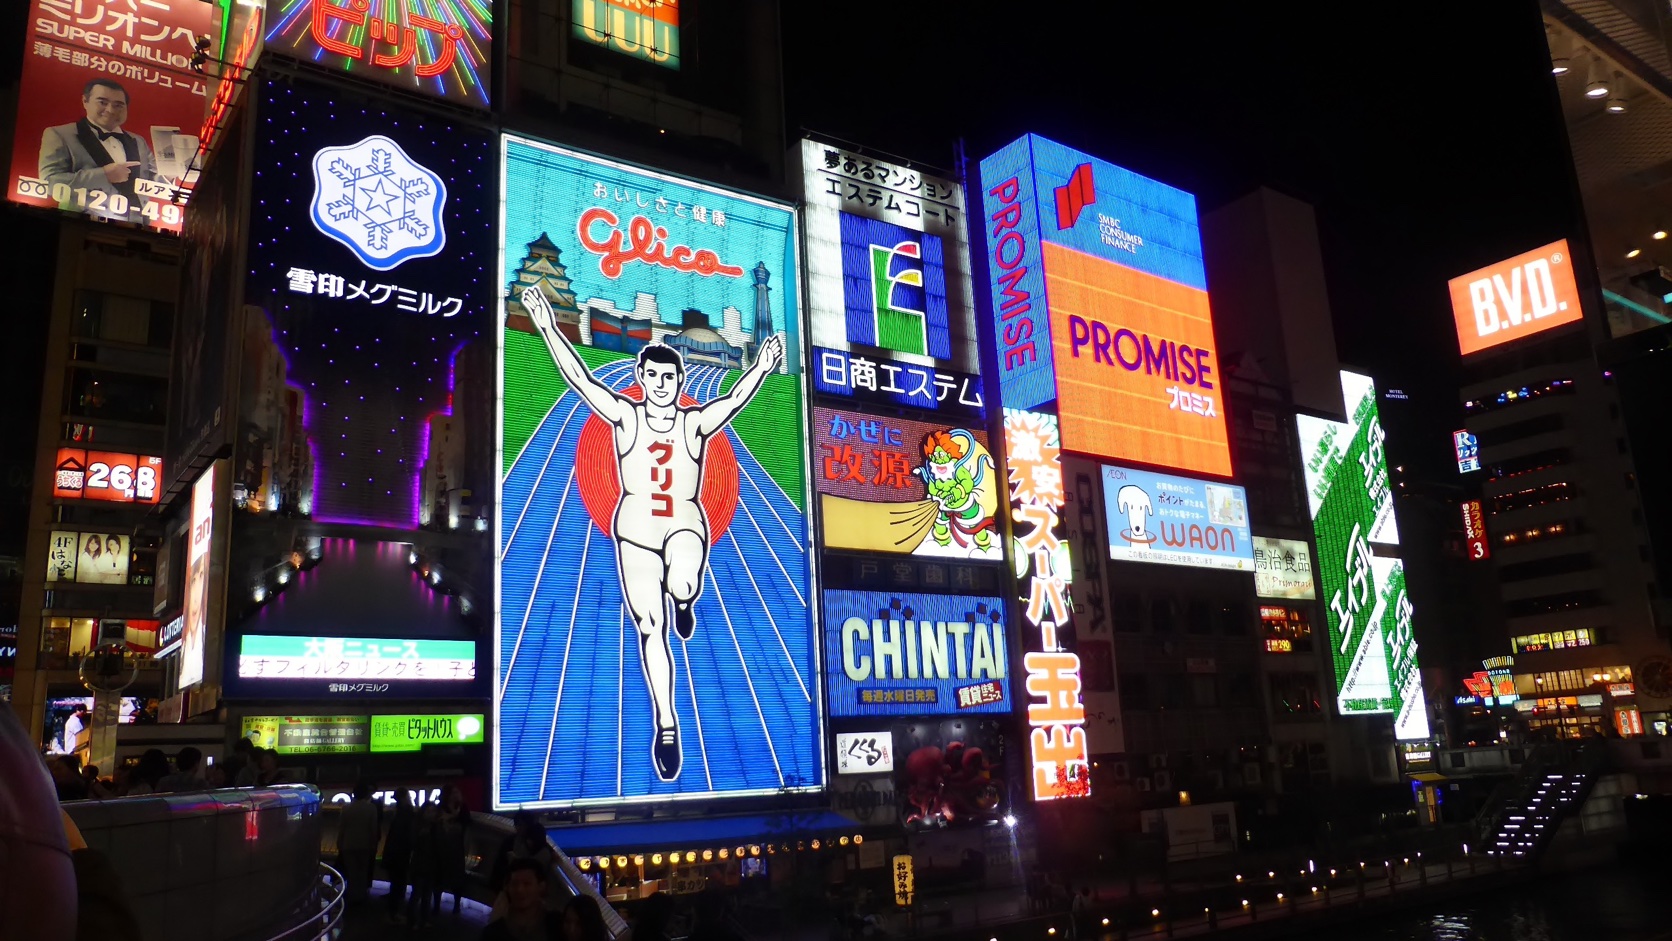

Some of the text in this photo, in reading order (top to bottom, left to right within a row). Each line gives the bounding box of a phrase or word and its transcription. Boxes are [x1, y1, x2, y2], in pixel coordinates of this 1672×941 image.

[35, 18, 115, 50] SUPER
[38, 0, 211, 47] ミリオンヘ
[33, 41, 207, 96] 薄毛部分のボリューム
[824, 149, 953, 200] 夢あるマンション
[52, 183, 183, 225] 0120-49
[592, 181, 727, 228] おいしさと健康
[826, 177, 956, 227] エステムコート
[1098, 213, 1121, 229] SMBC
[1099, 223, 1144, 247] CONSUMER
[1101, 233, 1137, 254] FINANCE
[286, 266, 463, 317] 雪印メグミルク
[989, 176, 1037, 372] PROMISE
[1469, 257, 1567, 337] B.V.D.
[1069, 314, 1214, 390] PROMISE
[822, 352, 984, 408] 日商エステム
[1166, 386, 1216, 417] プロミス
[828, 414, 903, 447] かぜに
[149, 456, 162, 465] 5F
[647, 438, 675, 517] グリコ
[821, 443, 912, 489] 改源
[54, 537, 73, 548] 4F
[1160, 520, 1236, 553] WAON
[1463, 503, 1475, 539] SHIDAX
[1473, 541, 1484, 558] 3
[1331, 527, 1374, 647] エイブル
[842, 616, 1006, 682] CHINTAI
[328, 683, 389, 693] 雪印メグミルク
[407, 718, 454, 740] ピタットハウス
